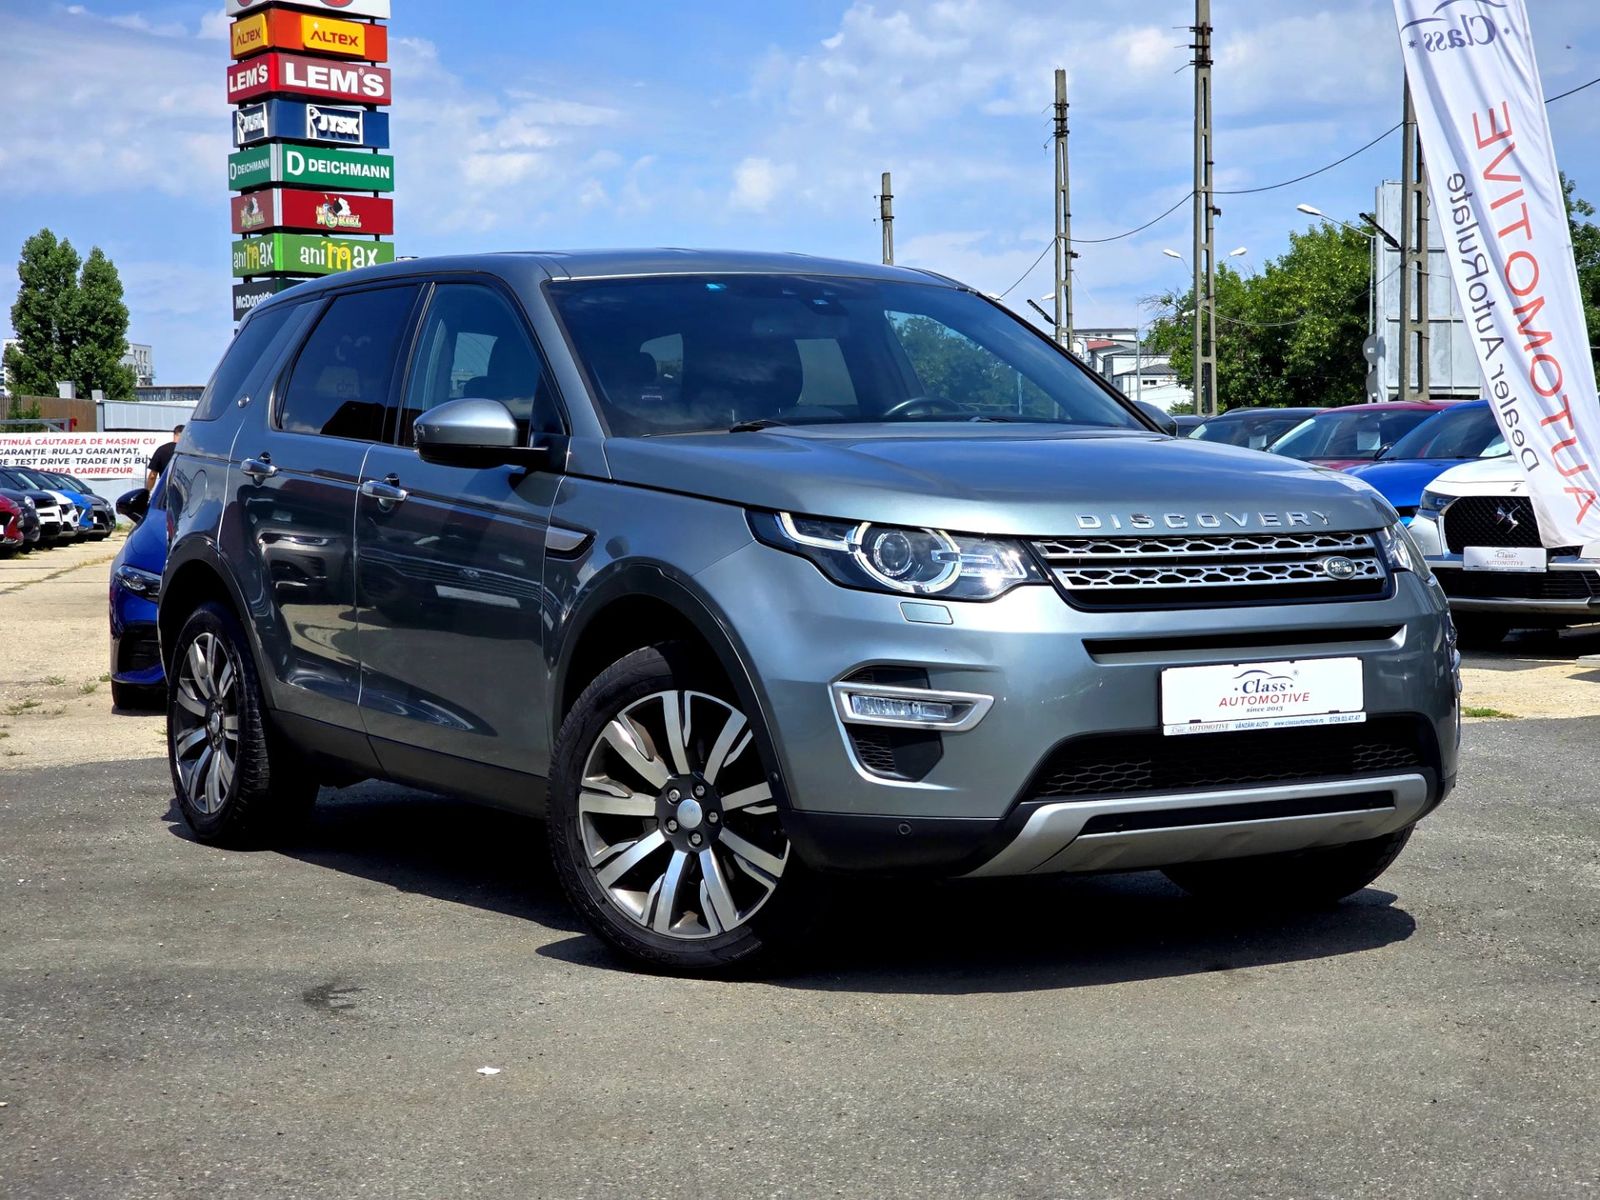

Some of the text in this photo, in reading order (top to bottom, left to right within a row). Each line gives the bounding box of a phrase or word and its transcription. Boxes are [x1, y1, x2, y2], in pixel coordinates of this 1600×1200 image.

[229, 63, 269, 93] LEM'S
[285, 62, 385, 97] LEM'S
[237, 158, 270, 175] DEICHMANN
[308, 158, 390, 179] DEICHMANN
[233, 241, 274, 270] animax
[300, 240, 378, 271] animax
[15, 458, 37, 466] TEST
[76, 457, 108, 465] TRADE
[110, 457, 121, 465] IN
[74, 467, 133, 475] CARREFOUR
[1074, 510, 1332, 529] DISCOVERY
[1242, 679, 1287, 694] Class
[1219, 692, 1310, 707] AUTOMOTIVE
